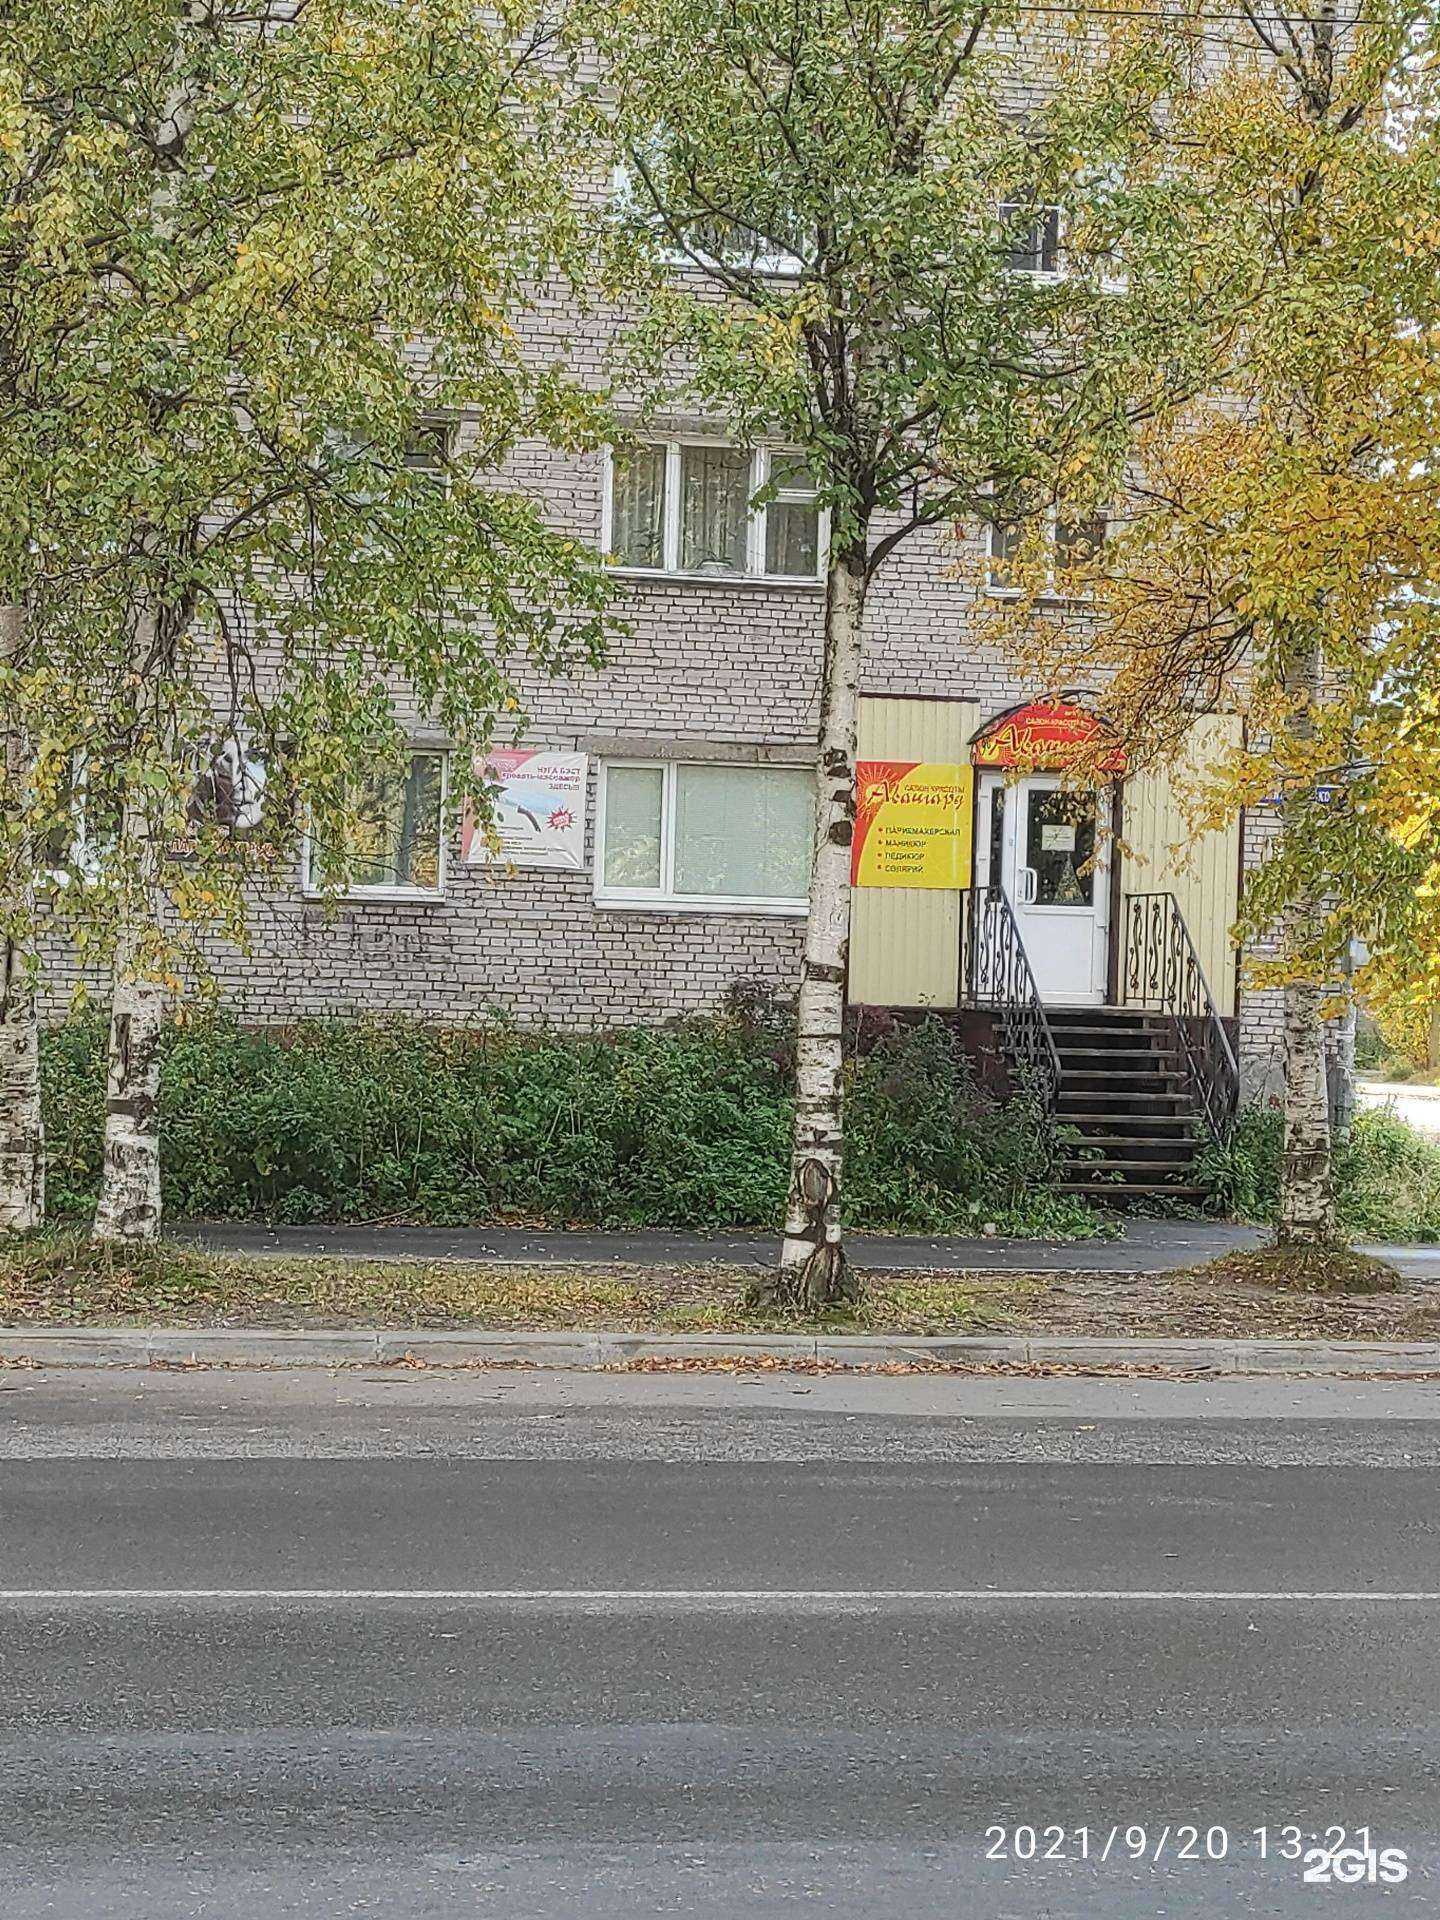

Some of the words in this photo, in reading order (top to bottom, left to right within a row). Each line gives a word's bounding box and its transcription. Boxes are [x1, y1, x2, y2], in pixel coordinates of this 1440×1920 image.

[885, 827, 961, 836] ПАРИКМАХЕРСКАЯ
[885, 840, 927, 849] МАНИКЮР
[885, 852, 925, 861] ПЕДИКЮР
[885, 864, 924, 873] СОЛЯРИЙ
